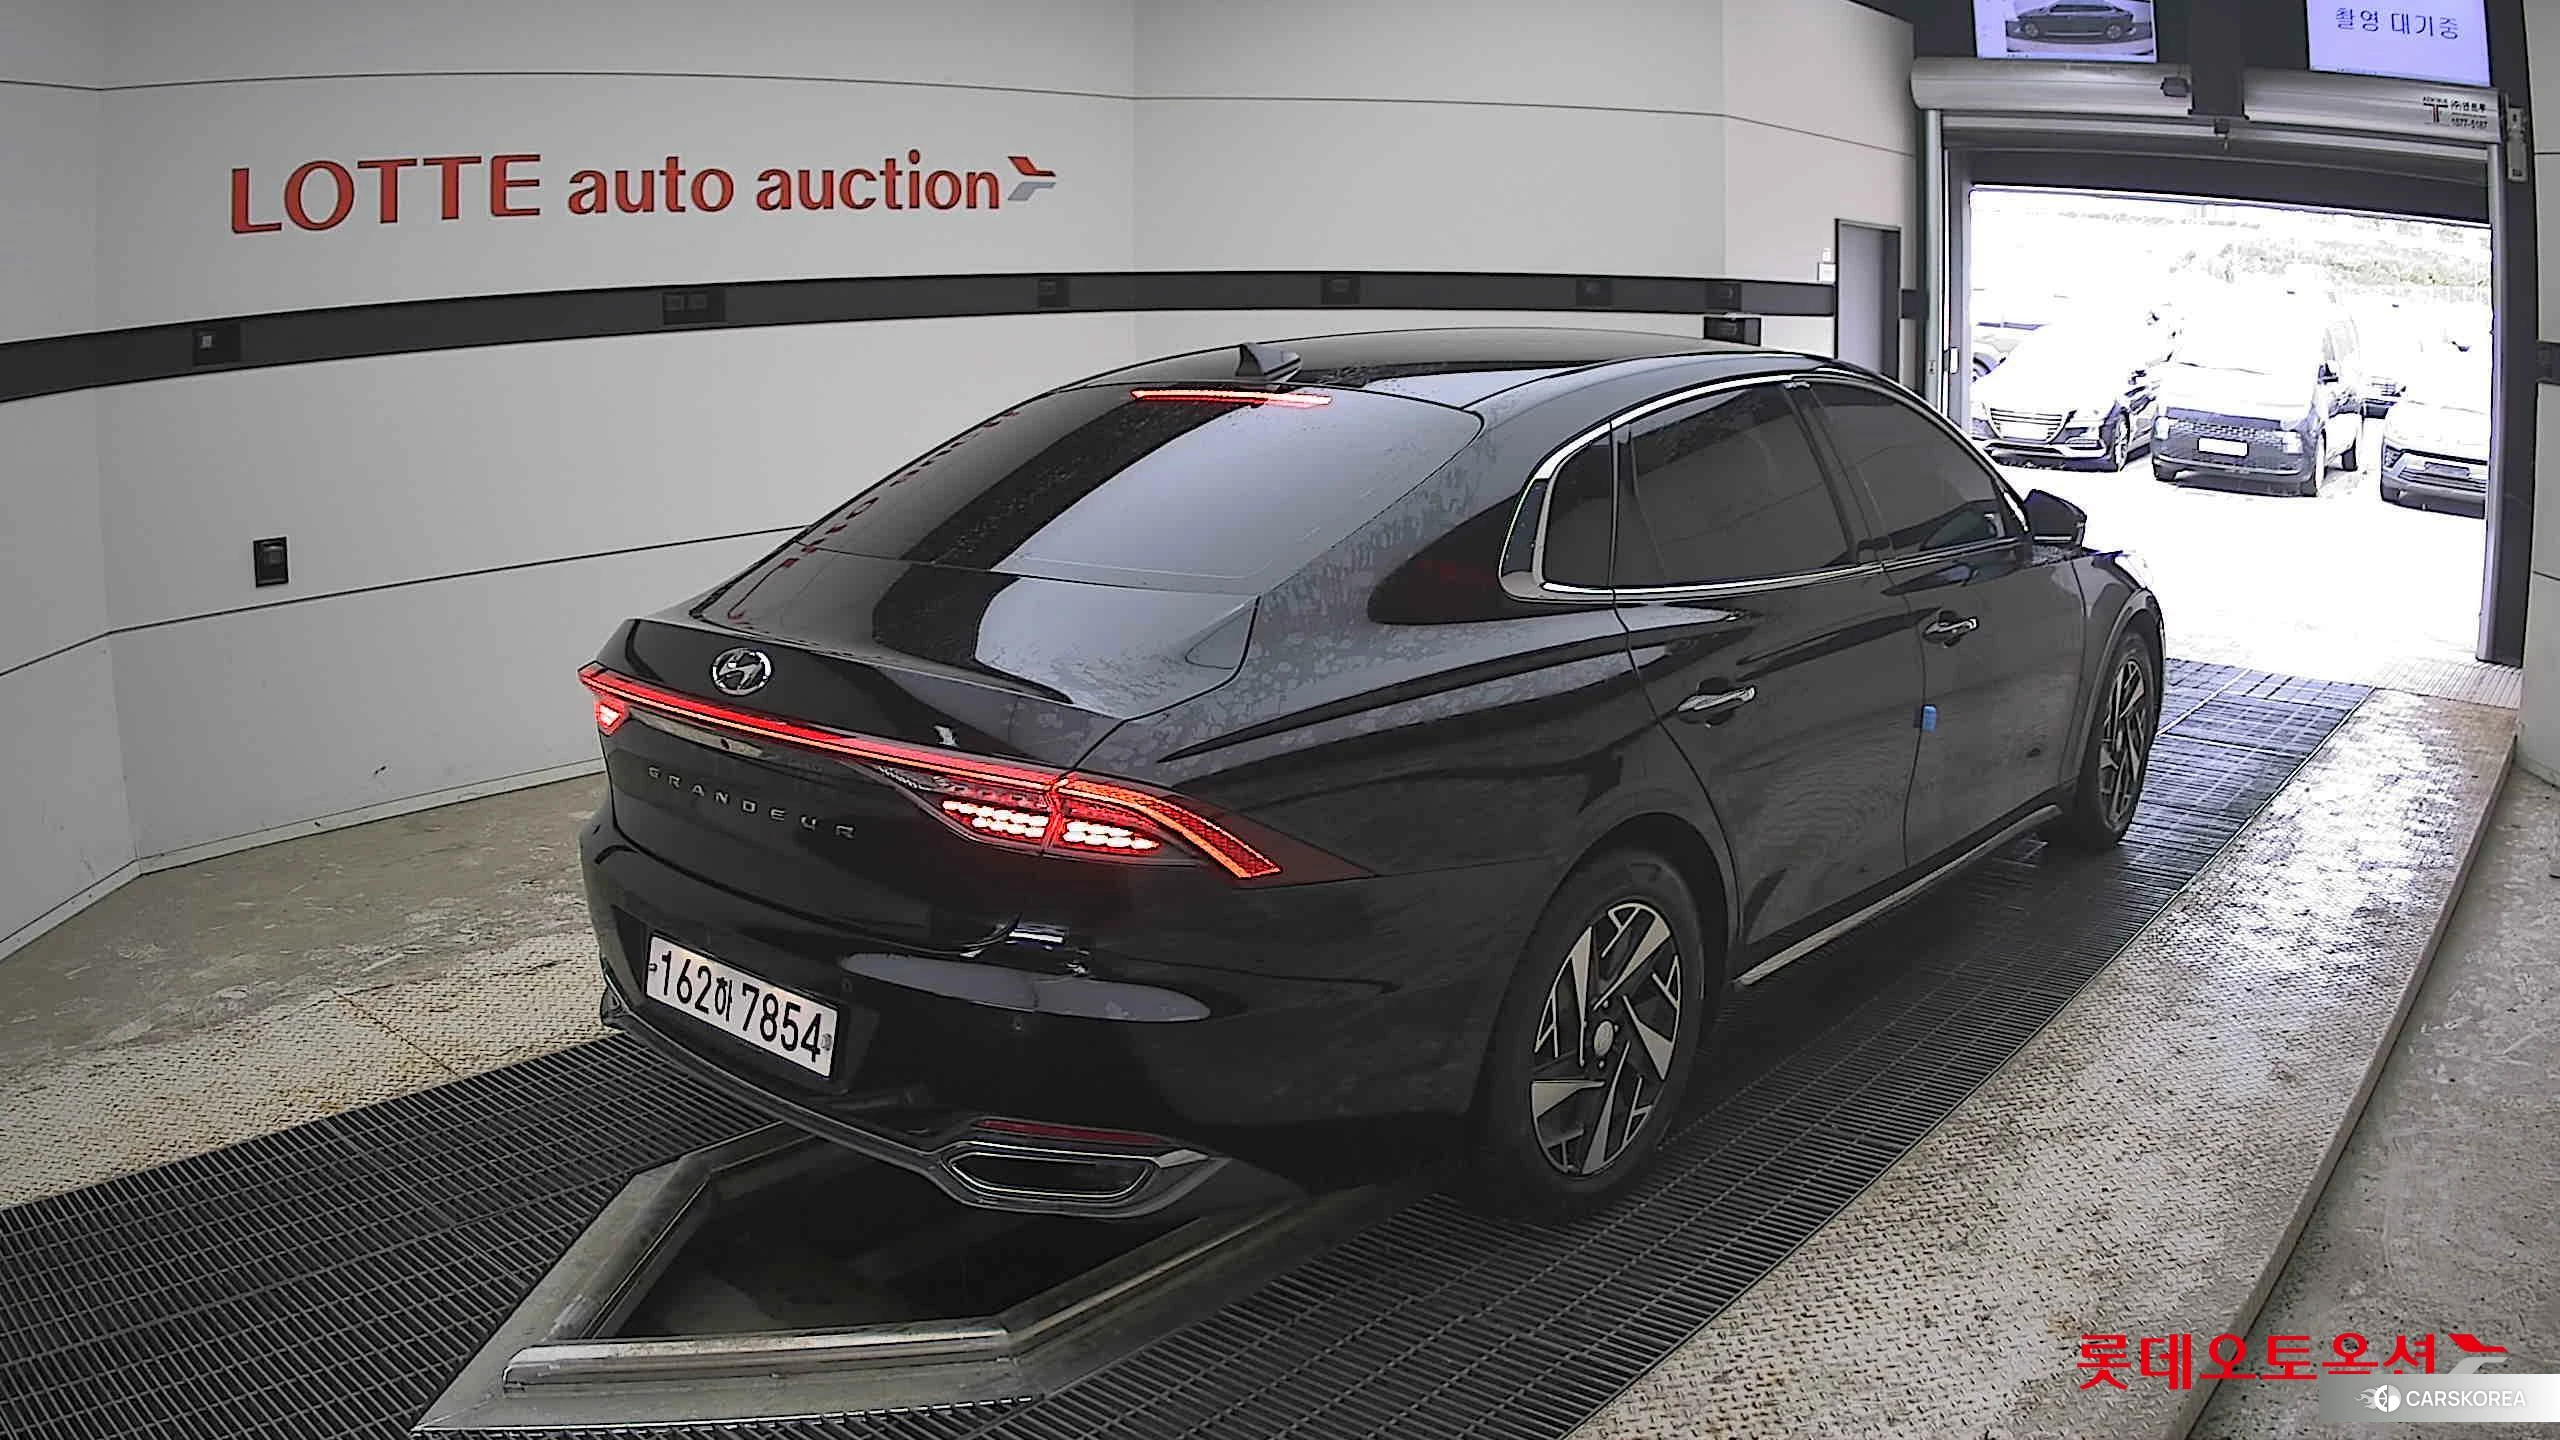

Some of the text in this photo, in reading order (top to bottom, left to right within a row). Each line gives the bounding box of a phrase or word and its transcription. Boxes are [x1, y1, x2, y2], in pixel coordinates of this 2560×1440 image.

[2335, 7, 2459, 40] 촬영 대기중
[231, 149, 1001, 234] LOTTE auto auction
[648, 766, 855, 839] GRANDEUR
